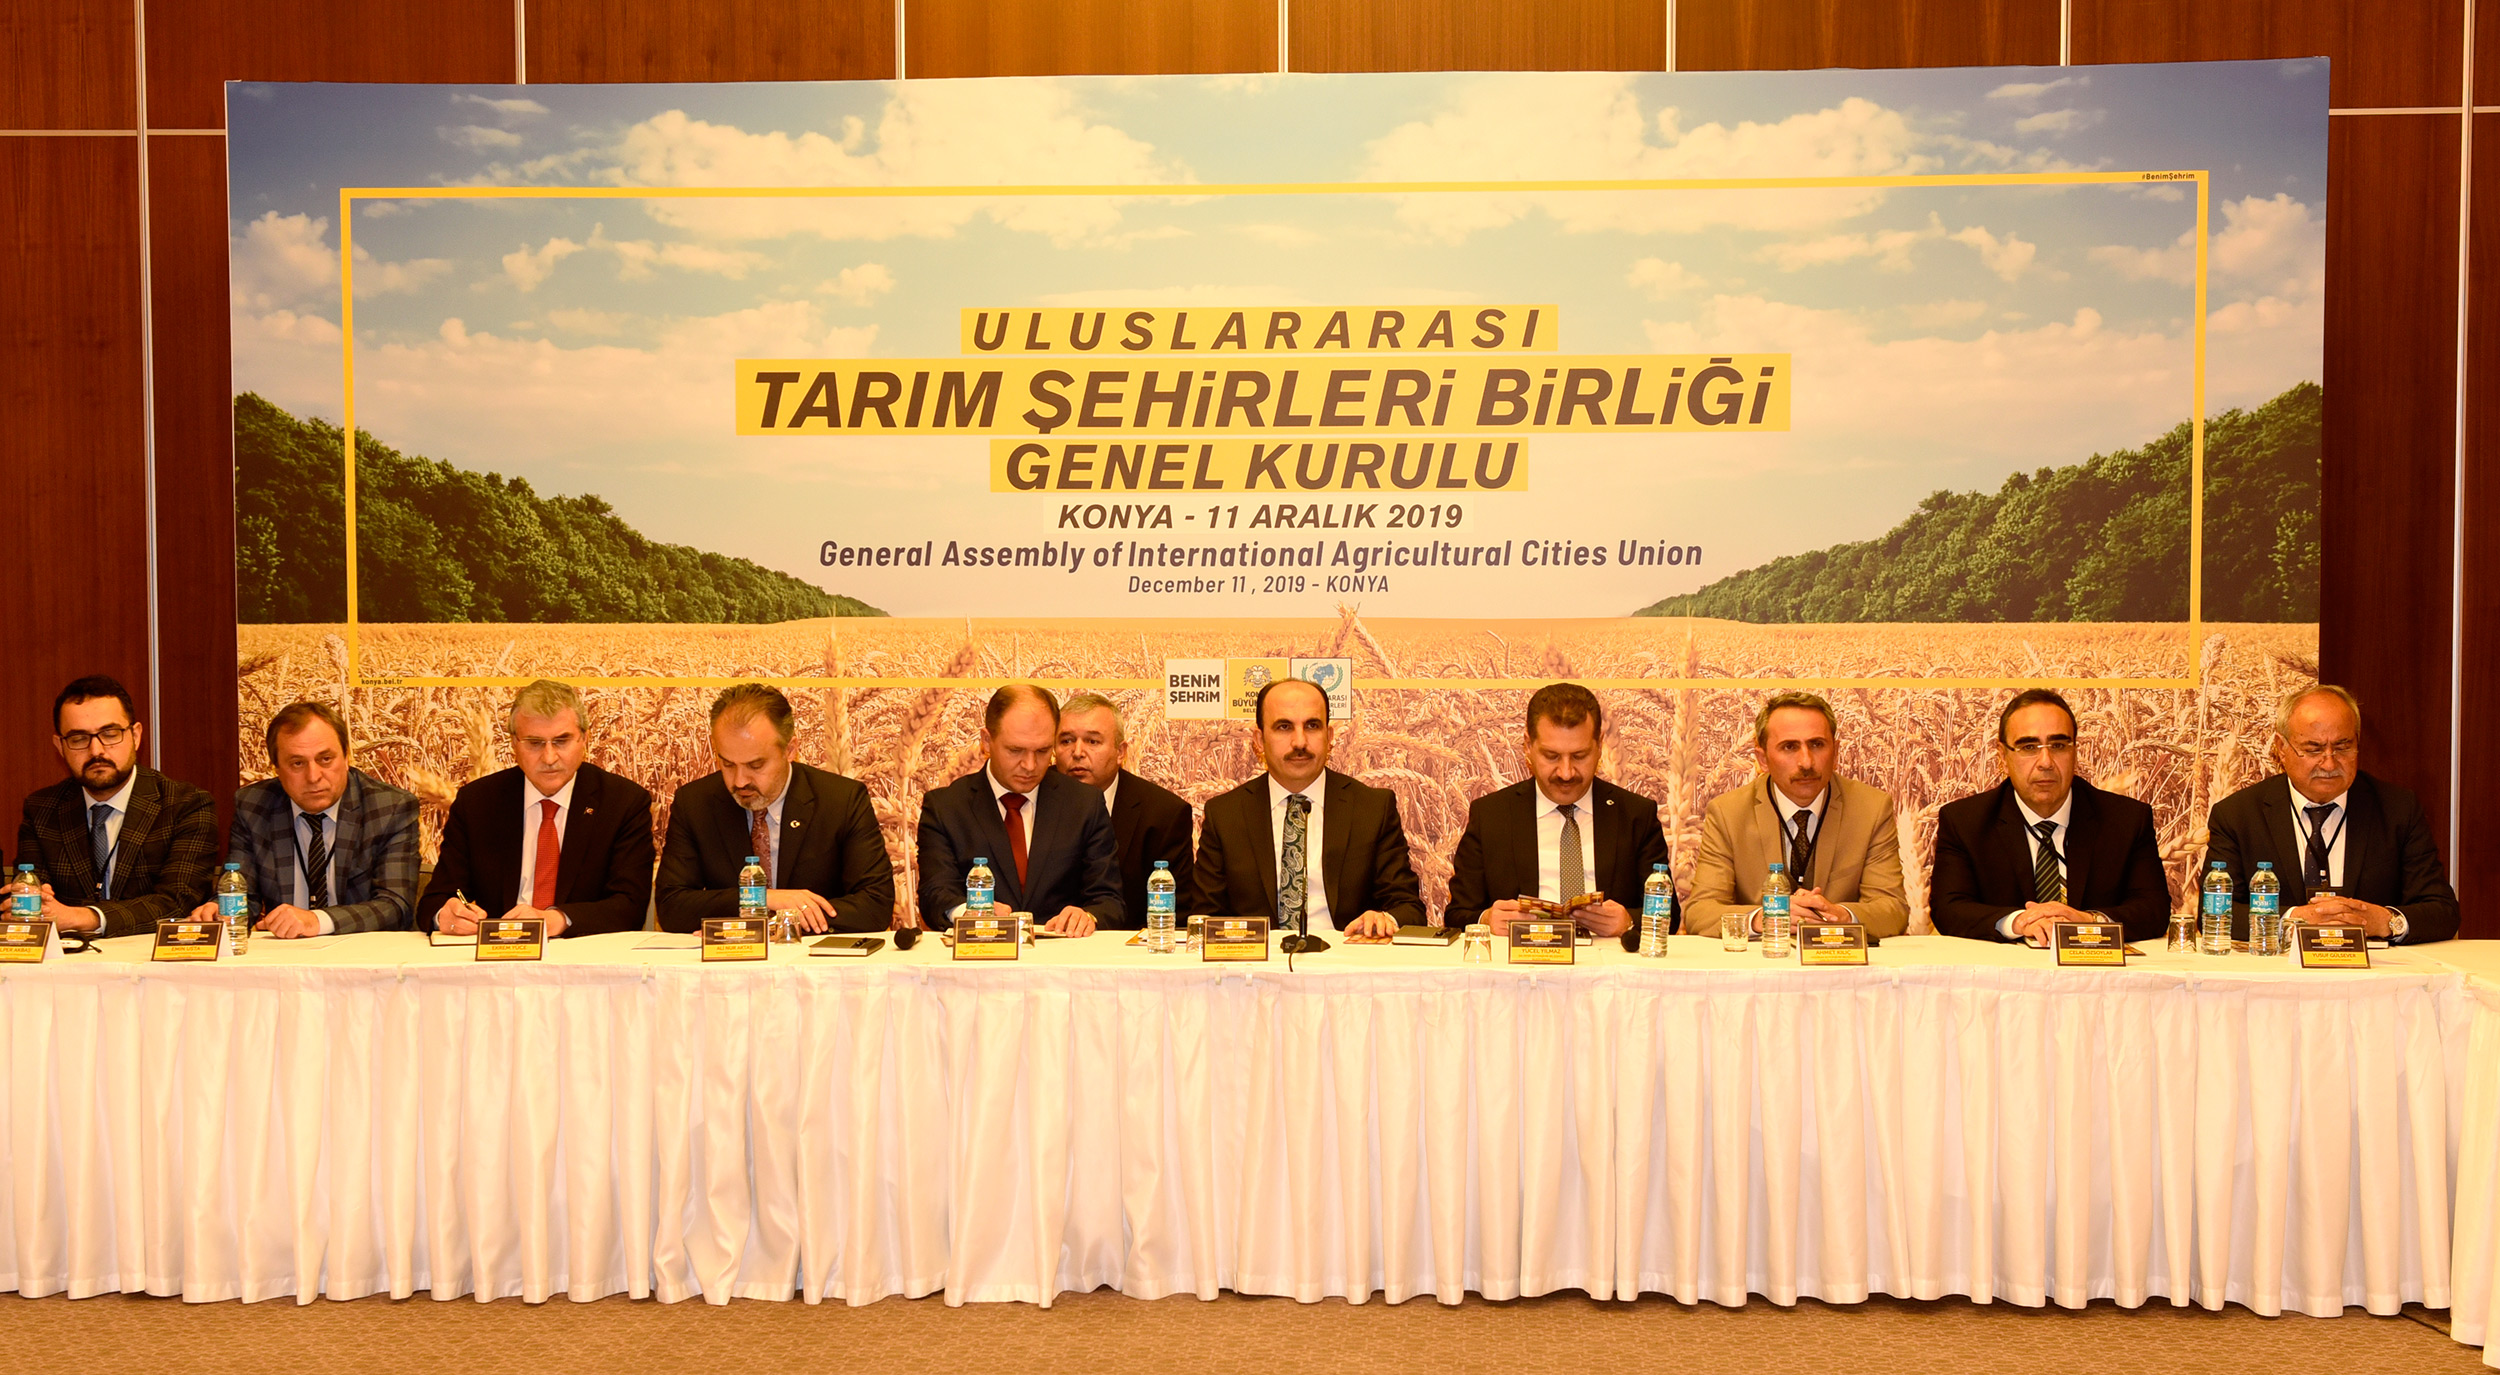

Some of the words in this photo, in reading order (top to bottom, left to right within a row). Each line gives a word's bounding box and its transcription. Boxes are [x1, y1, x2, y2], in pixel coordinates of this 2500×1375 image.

[973, 308, 1541, 350] ULUSLARARASI
[755, 371, 1005, 429] TARIM
[1005, 443, 1225, 490] GENEL
[1244, 442, 1519, 489] KURULU
[1058, 504, 1174, 529] KONYA
[1208, 505, 1240, 529] 11
[1248, 504, 1379, 529] ARALIK
[1386, 504, 1463, 529] 2019
[819, 540, 933, 567] General
[941, 540, 1086, 574] Assembly
[1093, 541, 1124, 567] of
[1128, 540, 1325, 567] International
[1330, 540, 1512, 574] Agricultural
[1521, 539, 1609, 567] Cities
[1618, 539, 1703, 567] Union
[1128, 575, 1226, 593] December
[1232, 575, 1247, 593] 11
[1263, 575, 1306, 593] 2019
[1326, 575, 1390, 593] KONYA
[361, 678, 403, 686] konya.bel.tr
